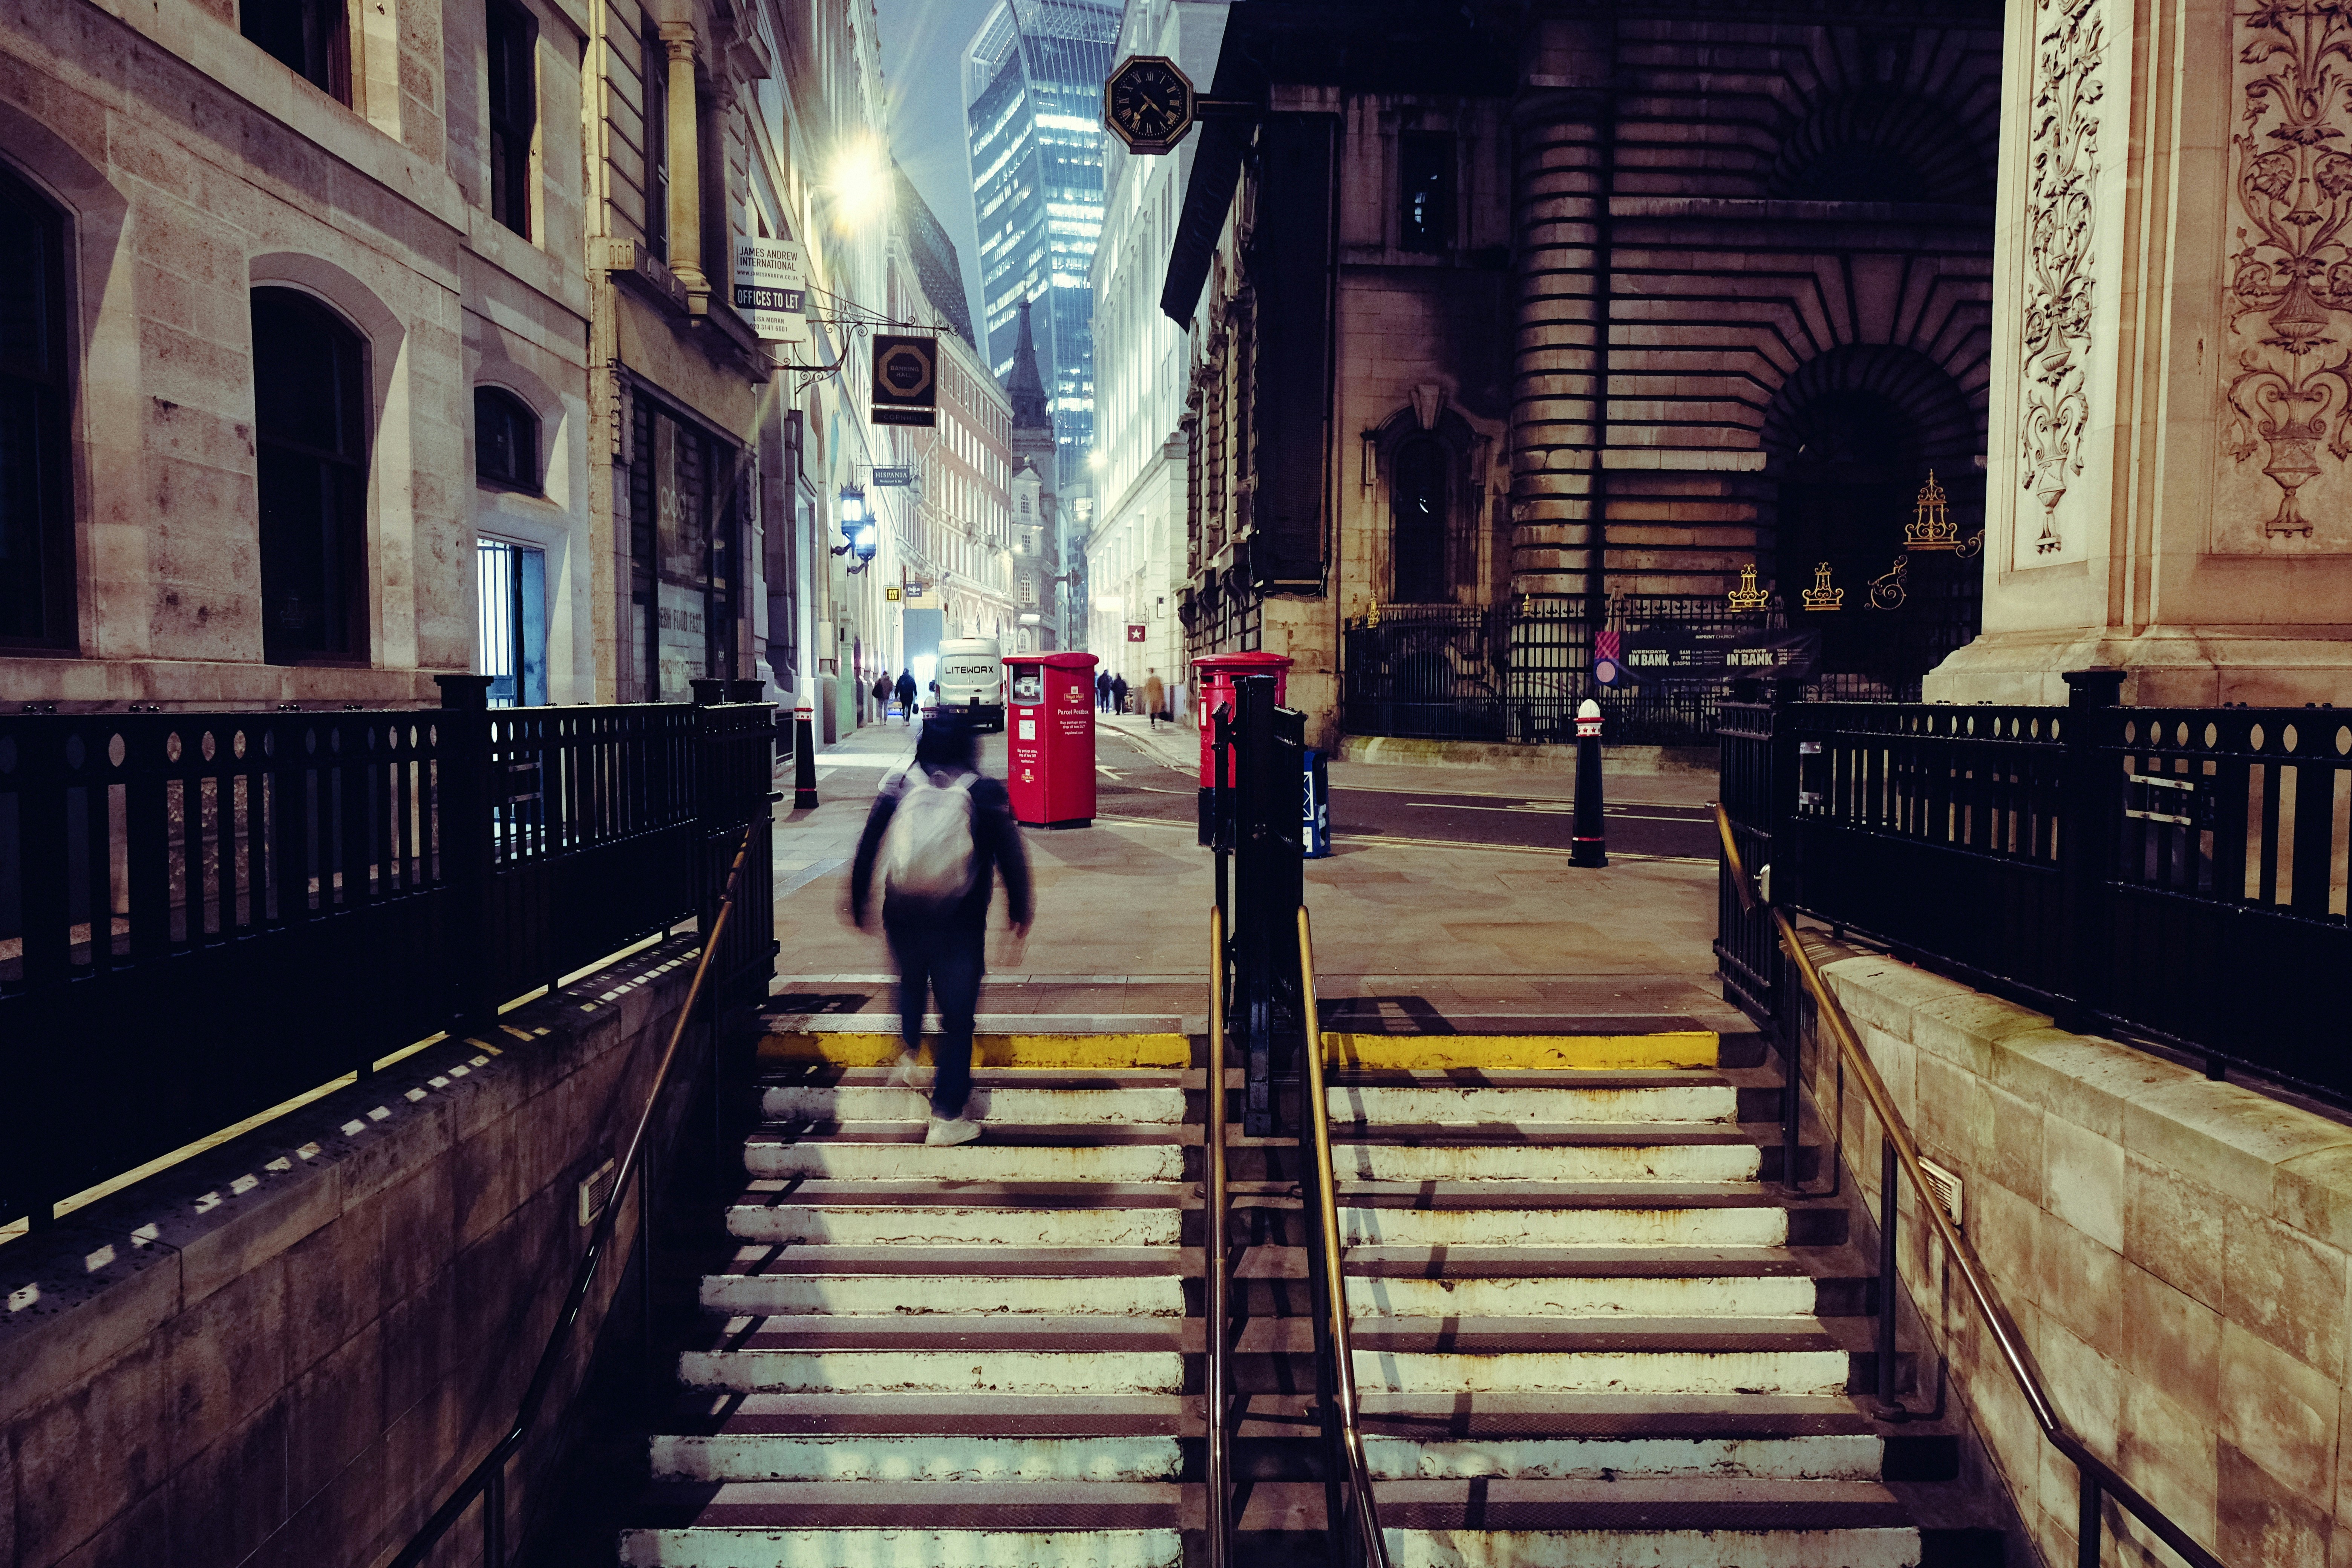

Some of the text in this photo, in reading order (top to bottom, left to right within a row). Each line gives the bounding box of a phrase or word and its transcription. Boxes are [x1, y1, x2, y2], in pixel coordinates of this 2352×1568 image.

[740, 246, 797, 261] JAMES ANDREW
[740, 257, 796, 271] INTERNATIONAL
[737, 270, 798, 280] WWW.JAMESANDREW.CO.UK
[738, 289, 799, 309] OFFICES TO LET
[661, 486, 686, 522] pod
[660, 606, 701, 633] ESH FOOD FAST
[661, 659, 680, 675] RIOUS
[1629, 654, 1669, 666] IN BANK
[1727, 654, 1738, 666] IN
[1741, 653, 1773, 666] BANK
